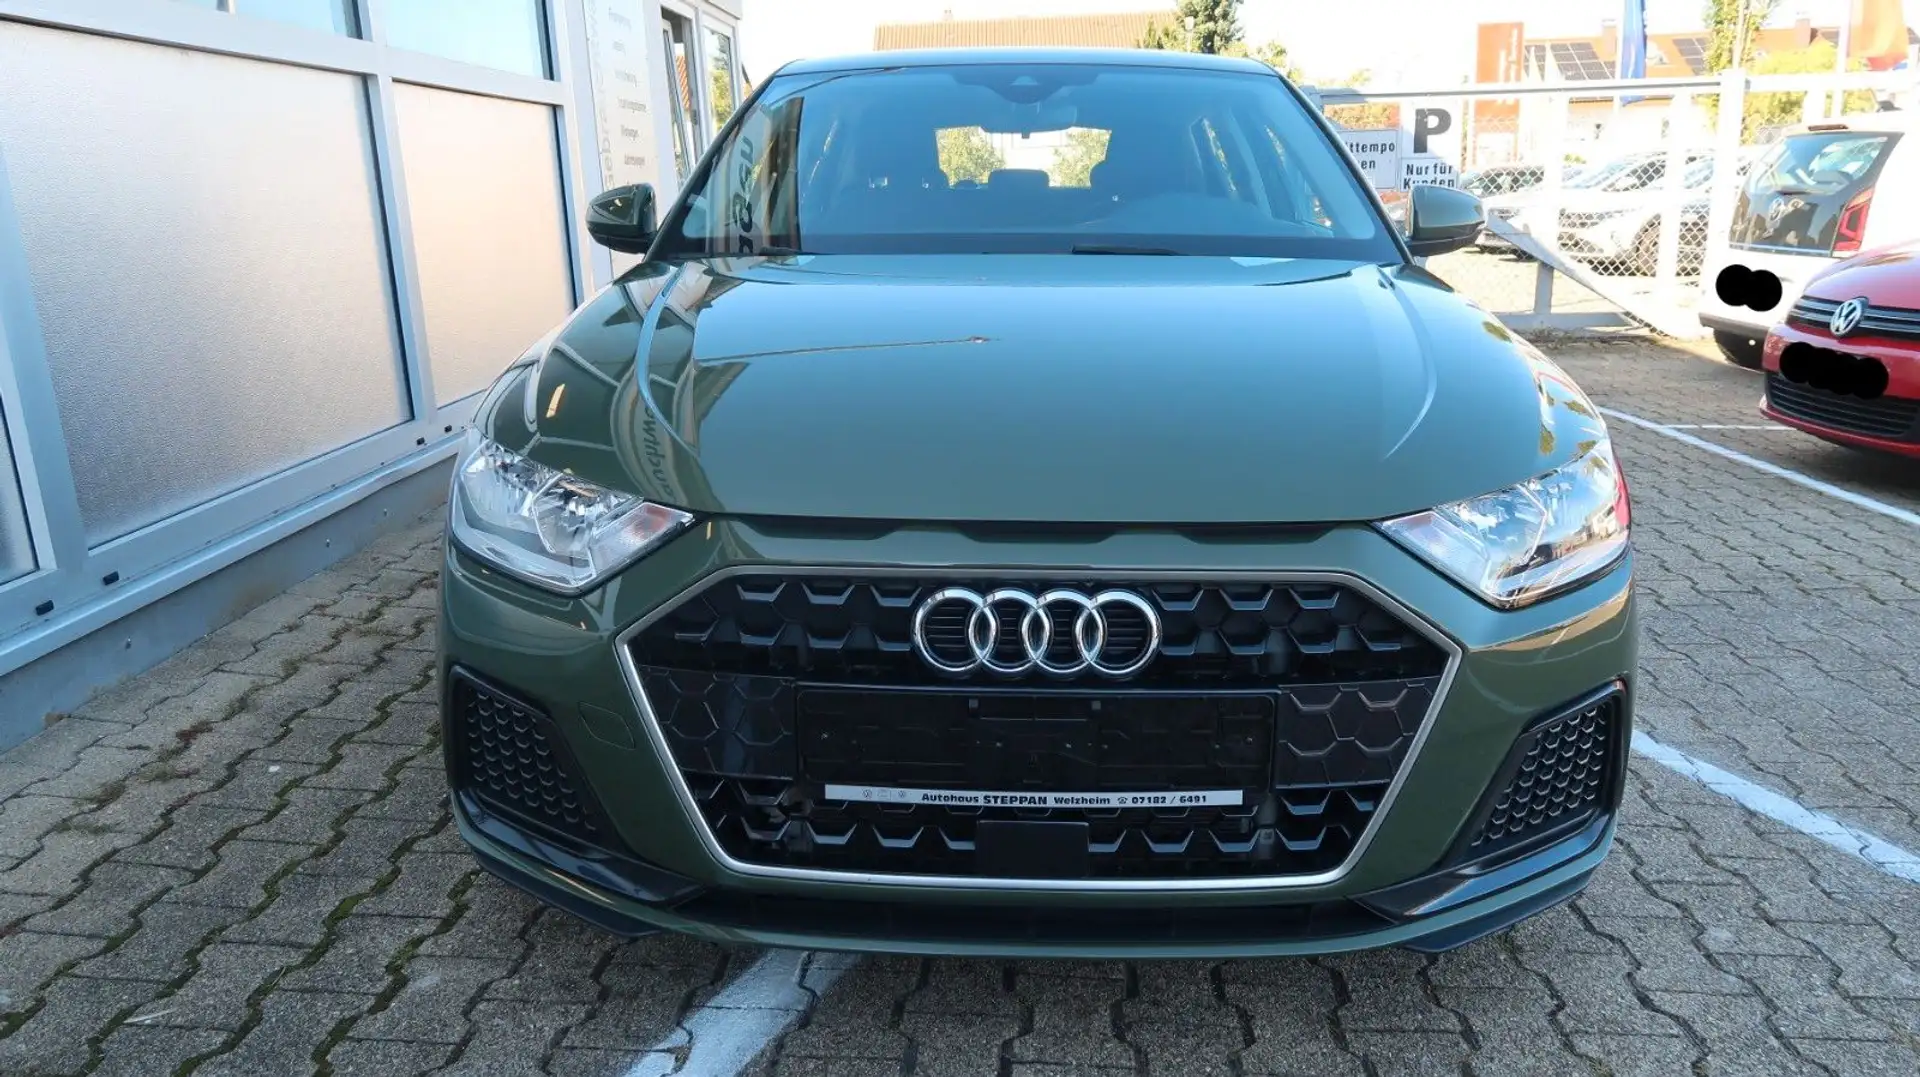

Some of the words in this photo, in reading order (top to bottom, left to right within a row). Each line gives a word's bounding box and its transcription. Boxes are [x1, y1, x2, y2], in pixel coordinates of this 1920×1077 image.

[1413, 108, 1452, 154] P
[1345, 142, 1395, 154] ttempo
[1358, 160, 1376, 170] en
[1406, 163, 1429, 175] Nur
[1433, 162, 1452, 175] für
[921, 793, 979, 803] Autohaus
[983, 795, 1047, 805] STEPPAN
[1054, 796, 1110, 805] Welzheim
[1131, 796, 1166, 804] 07182
[1180, 795, 1207, 804] 6491
